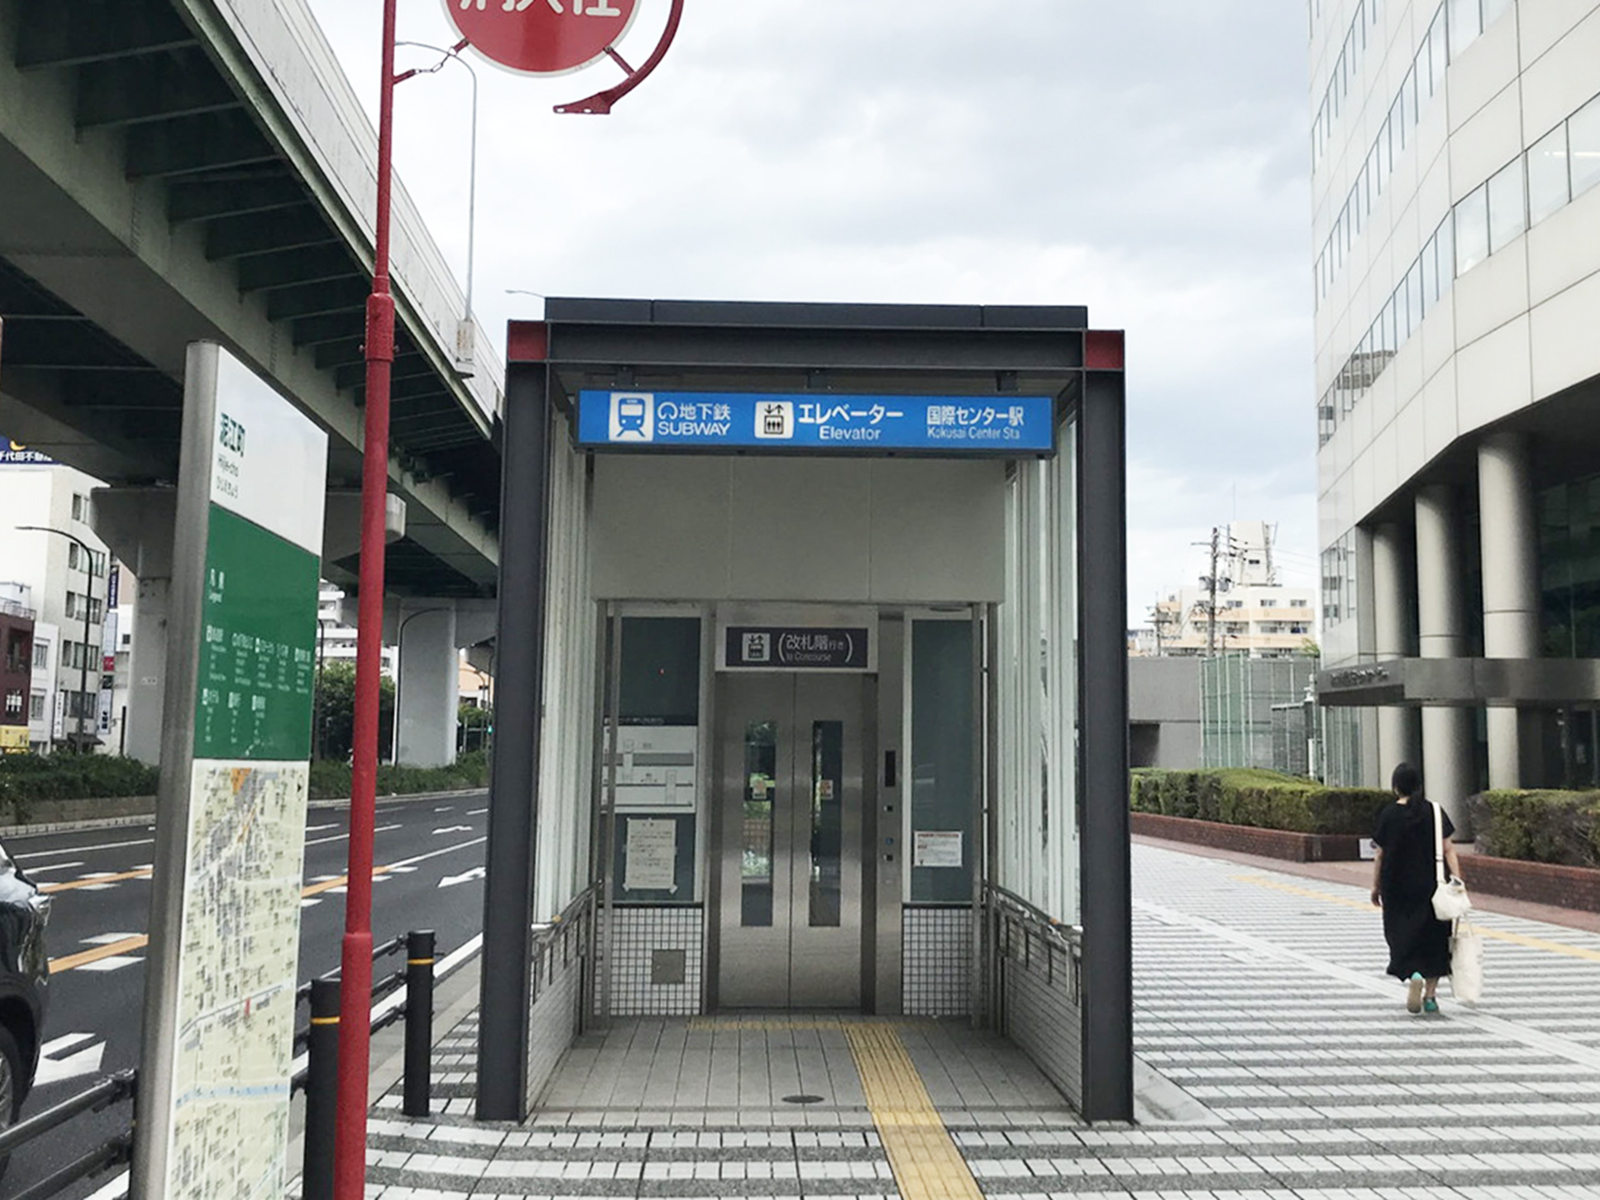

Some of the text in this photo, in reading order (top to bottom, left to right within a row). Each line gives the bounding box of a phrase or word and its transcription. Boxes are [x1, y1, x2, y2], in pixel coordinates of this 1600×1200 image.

[679, 403, 731, 421] 地下鉄
[797, 403, 904, 425] エレベーター
[926, 405, 1024, 426] 国際センター駅
[657, 421, 731, 436] SUBWAY
[819, 425, 881, 440] Elevator
[926, 426, 967, 440] Kokusai
[968, 426, 1002, 440] Center
